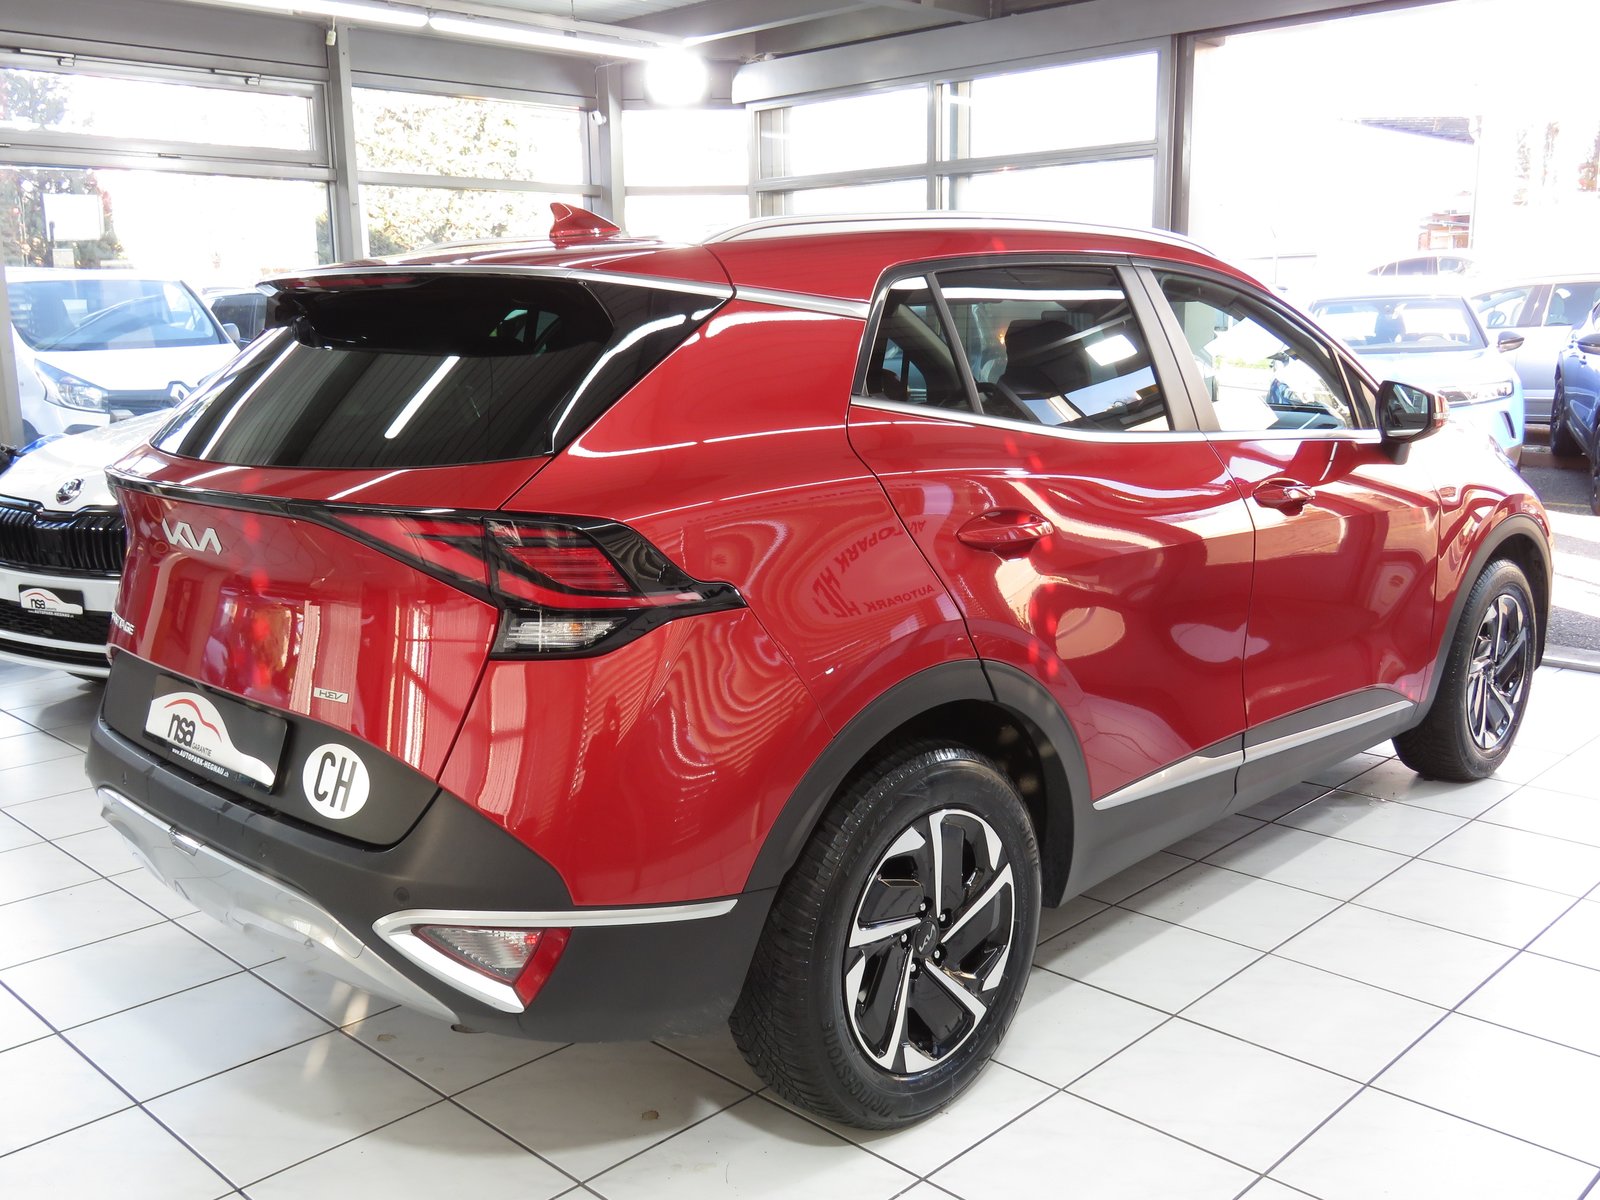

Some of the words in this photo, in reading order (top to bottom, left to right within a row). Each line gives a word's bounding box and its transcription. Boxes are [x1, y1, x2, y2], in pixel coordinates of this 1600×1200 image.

[161, 517, 223, 555] KIA
[30, 598, 46, 610] nsa
[319, 690, 343, 700] HEV
[167, 713, 196, 748] nsa
[191, 742, 213, 757] GARANTIE
[313, 751, 358, 812] CH
